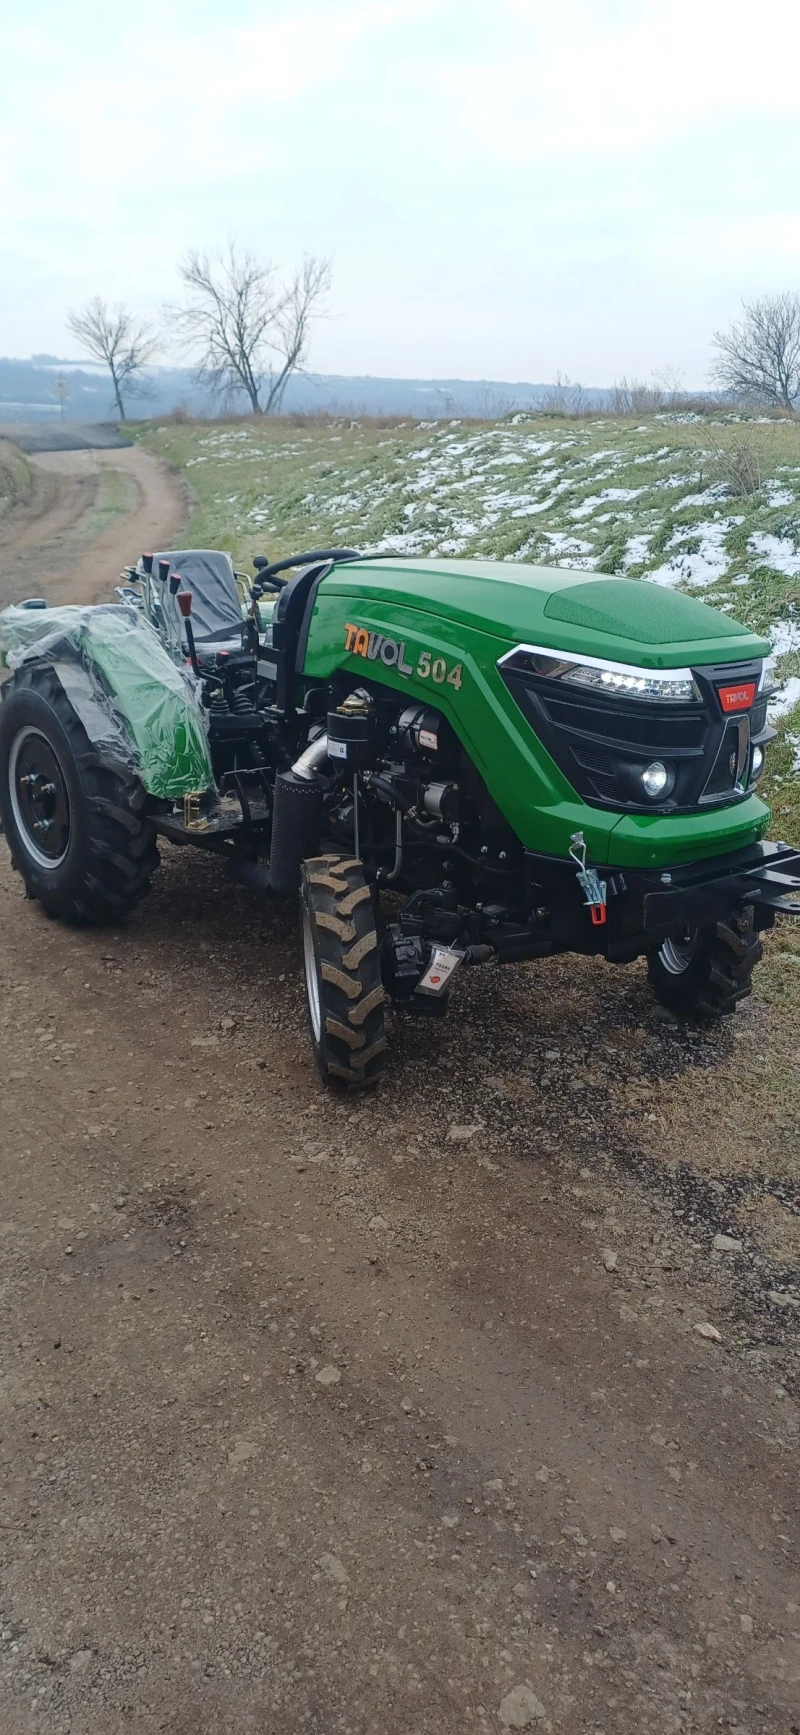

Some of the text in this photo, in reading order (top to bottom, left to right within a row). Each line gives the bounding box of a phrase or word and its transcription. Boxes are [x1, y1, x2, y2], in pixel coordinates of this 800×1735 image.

[344, 622, 463, 691] TAVOL 504
[725, 691, 749, 703] TAVOL
